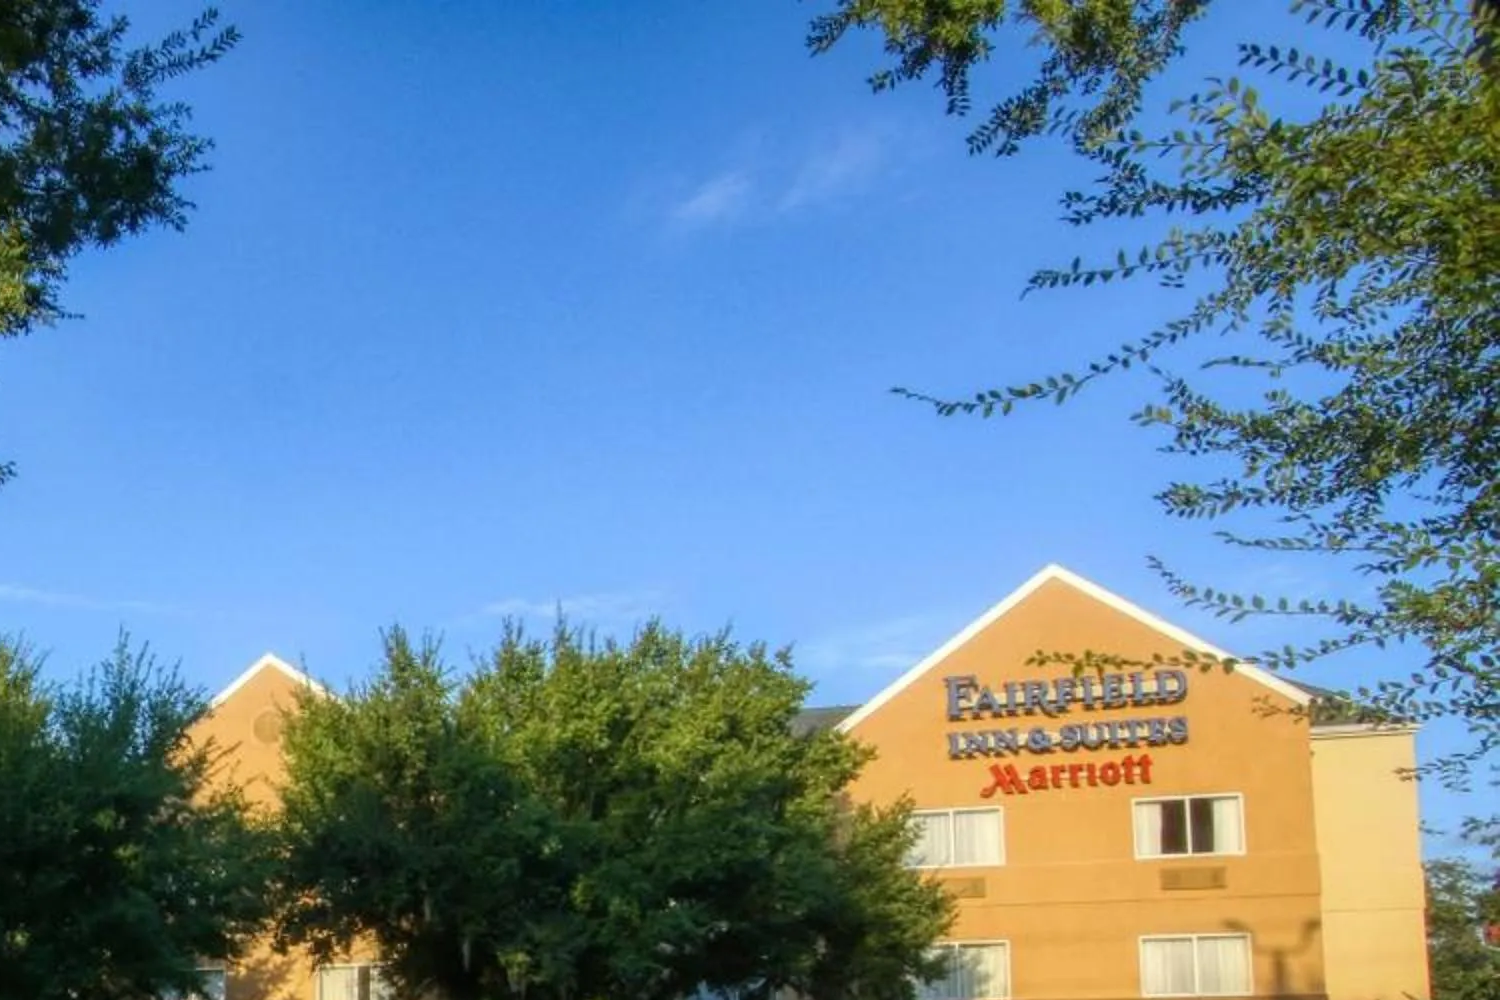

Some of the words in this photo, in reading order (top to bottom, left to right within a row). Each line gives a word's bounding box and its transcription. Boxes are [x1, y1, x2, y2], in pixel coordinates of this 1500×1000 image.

[945, 670, 1188, 721] FAIRFIELD
[947, 728, 1018, 760] INN
[1028, 727, 1051, 754] &
[1060, 716, 1188, 750] SUITES
[980, 754, 1153, 798] Marriott
